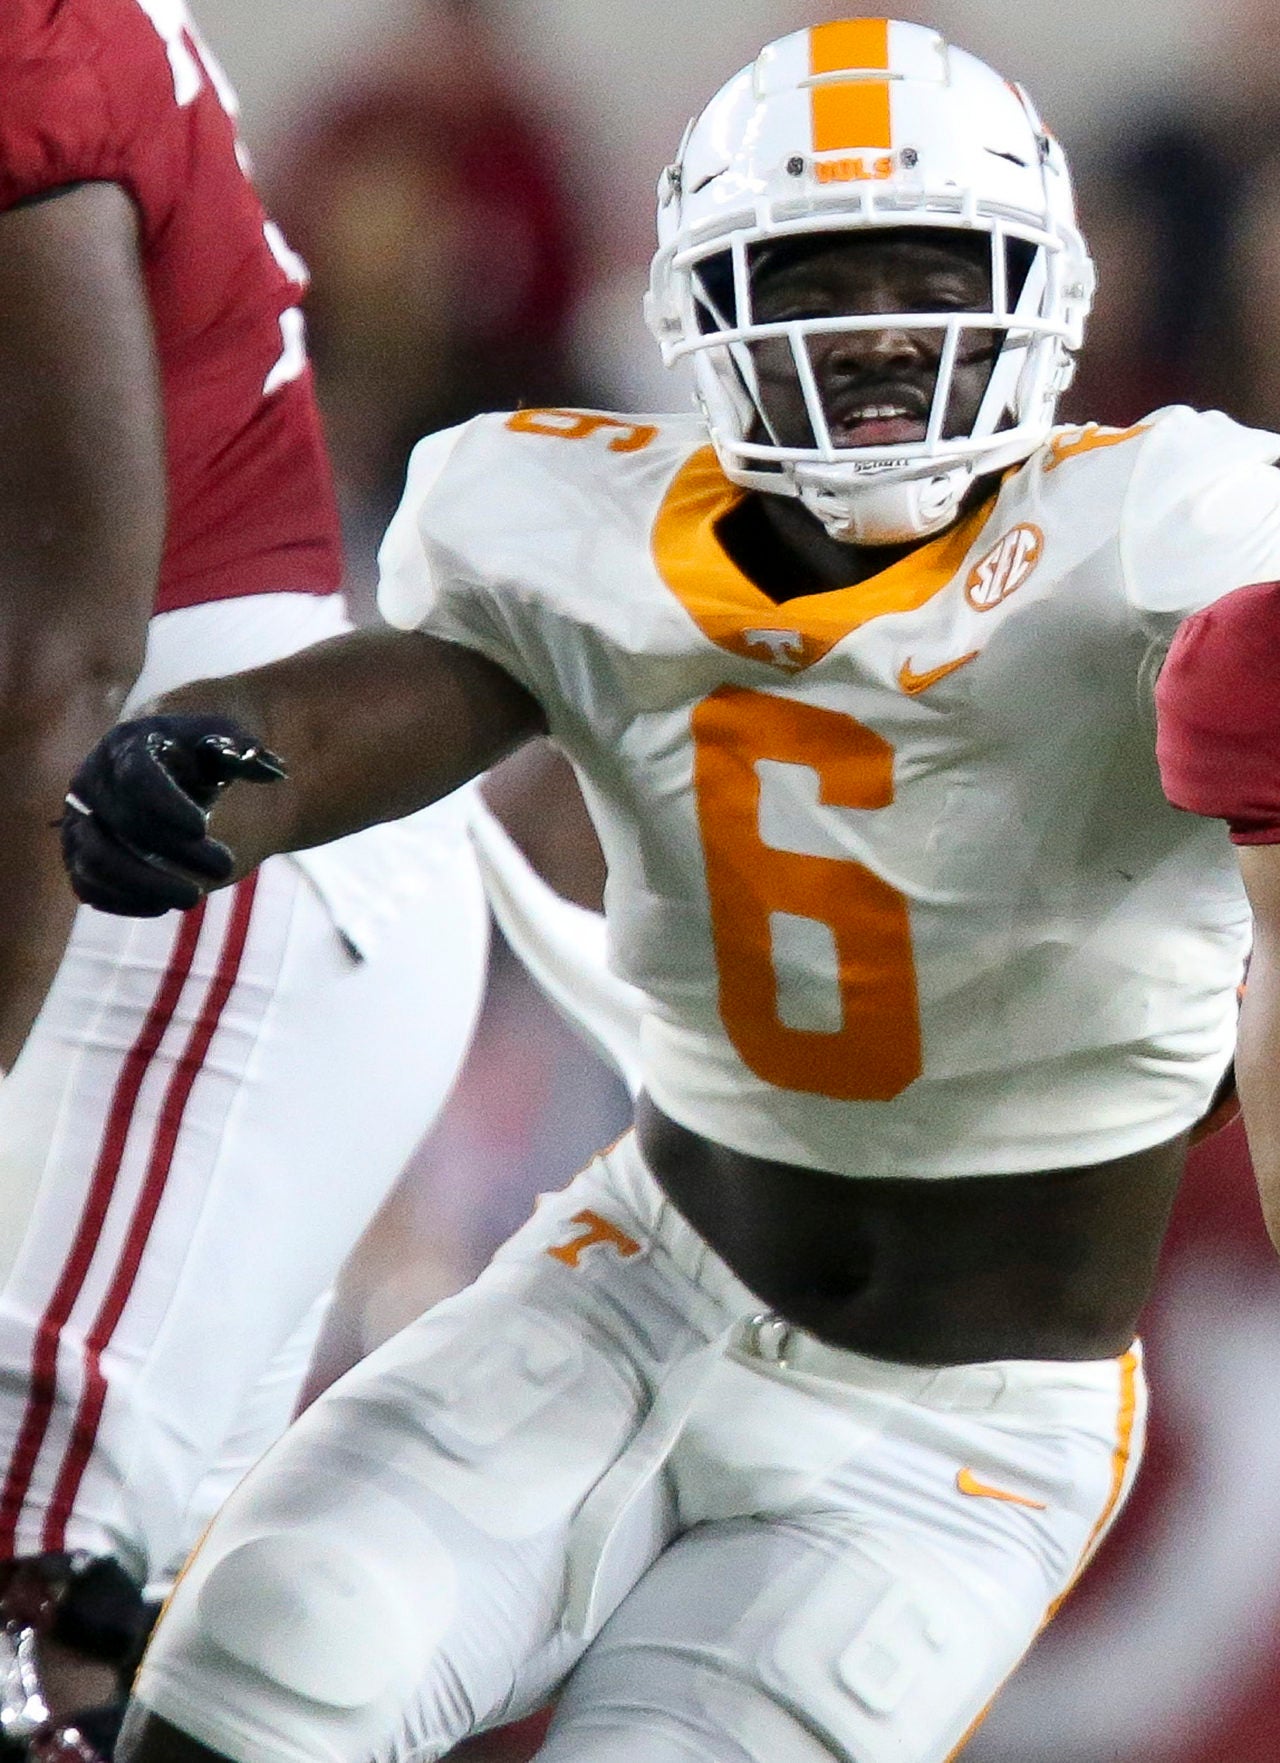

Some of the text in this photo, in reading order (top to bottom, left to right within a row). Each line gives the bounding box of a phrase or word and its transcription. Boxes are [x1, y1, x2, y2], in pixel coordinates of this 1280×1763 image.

[970, 529, 1036, 604] SEC
[743, 628, 803, 668] T
[691, 683, 924, 1101] 6
[547, 1208, 641, 1268] T
